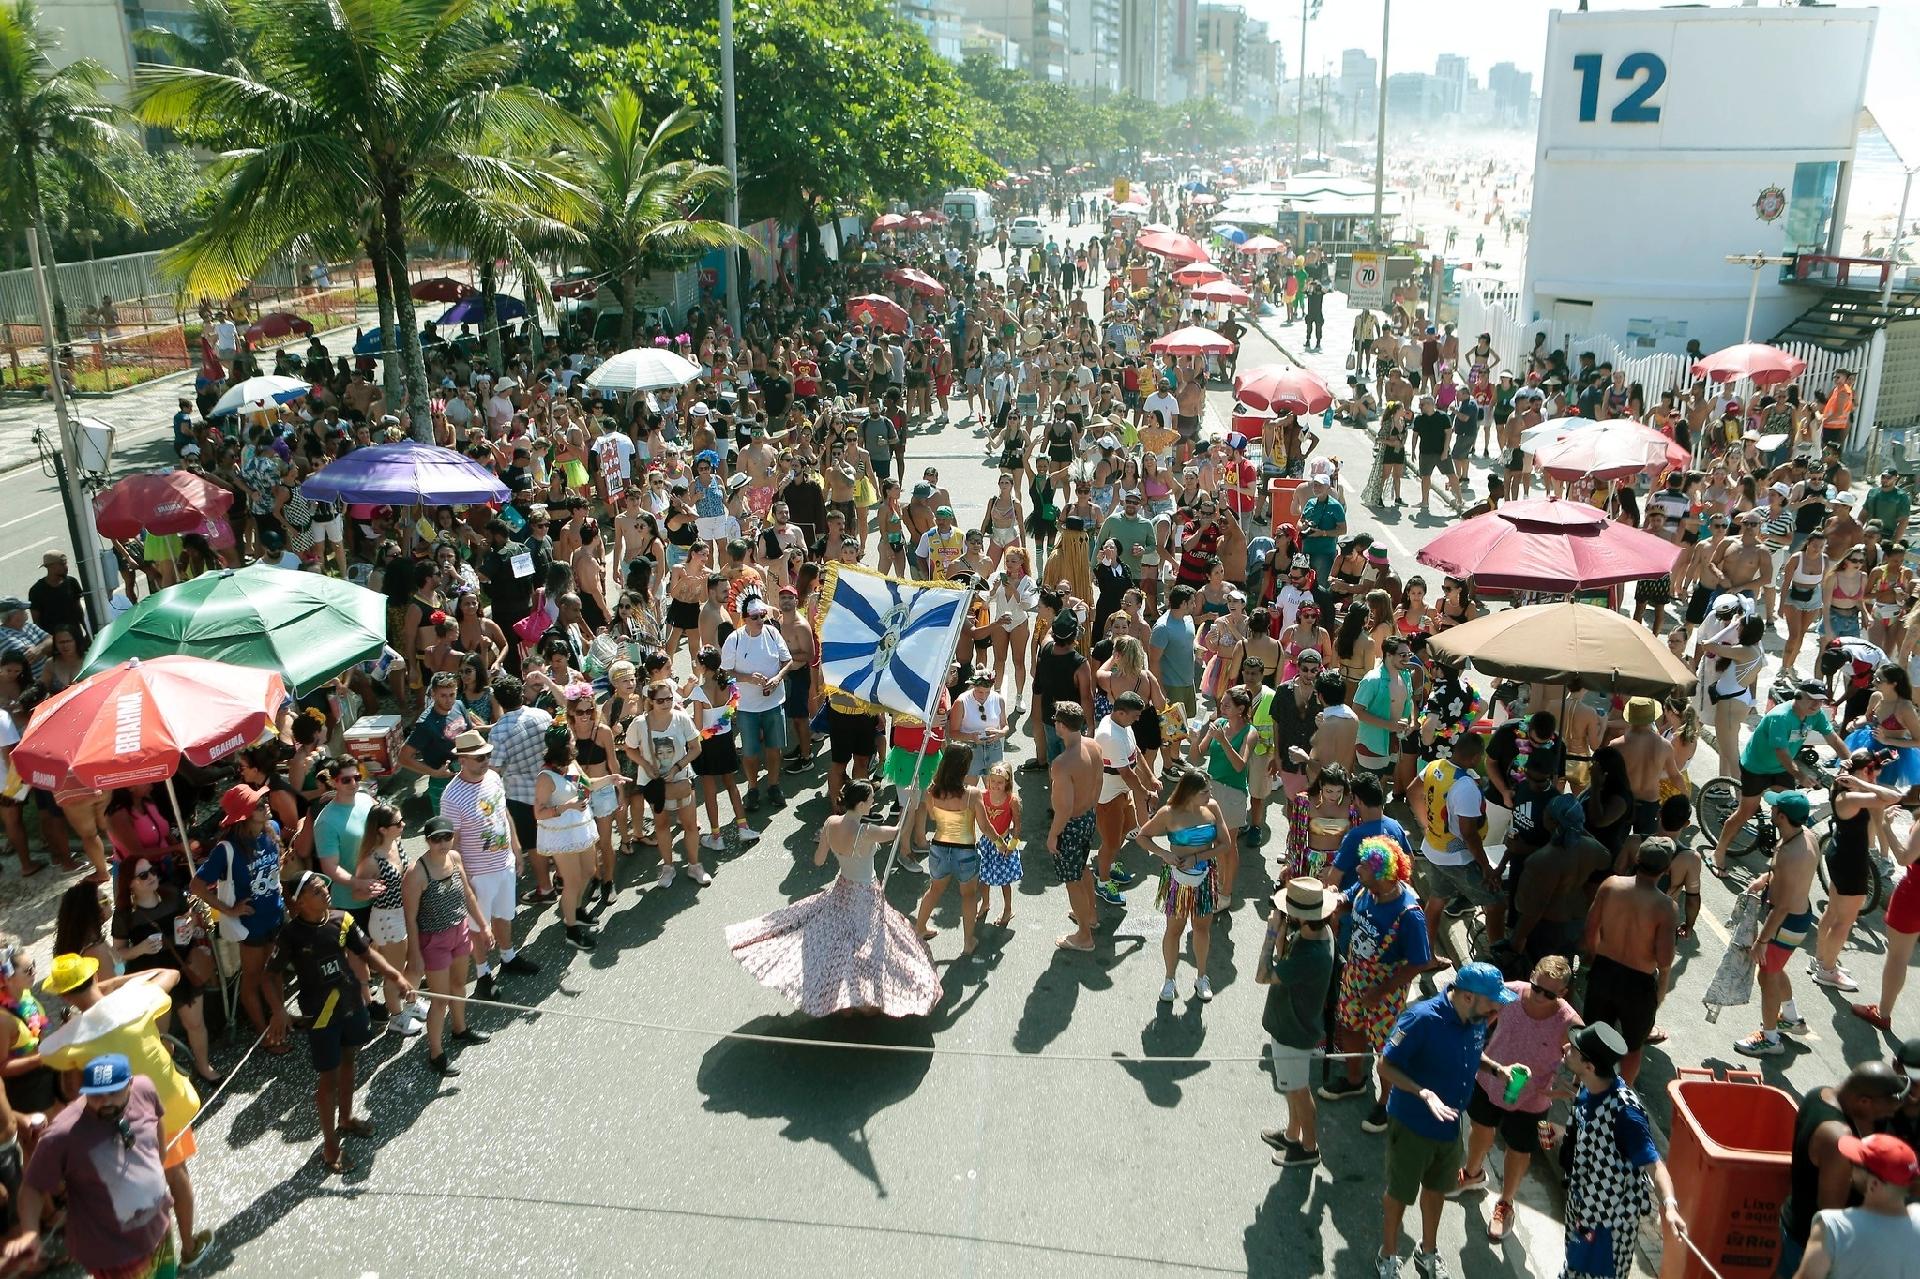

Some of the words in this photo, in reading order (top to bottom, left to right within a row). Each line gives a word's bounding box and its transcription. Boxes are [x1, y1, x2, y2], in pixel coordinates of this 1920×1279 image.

[1572, 52, 1667, 123] 12
[1362, 269, 1375, 282] 70
[116, 691, 143, 754] BRAHMA
[209, 733, 245, 760] BRAHMA
[1513, 810, 1534, 828] adidas
[321, 959, 341, 976] 1&1
[1743, 1198, 1776, 1209] Lixo
[1746, 1235, 1776, 1249] Rio
